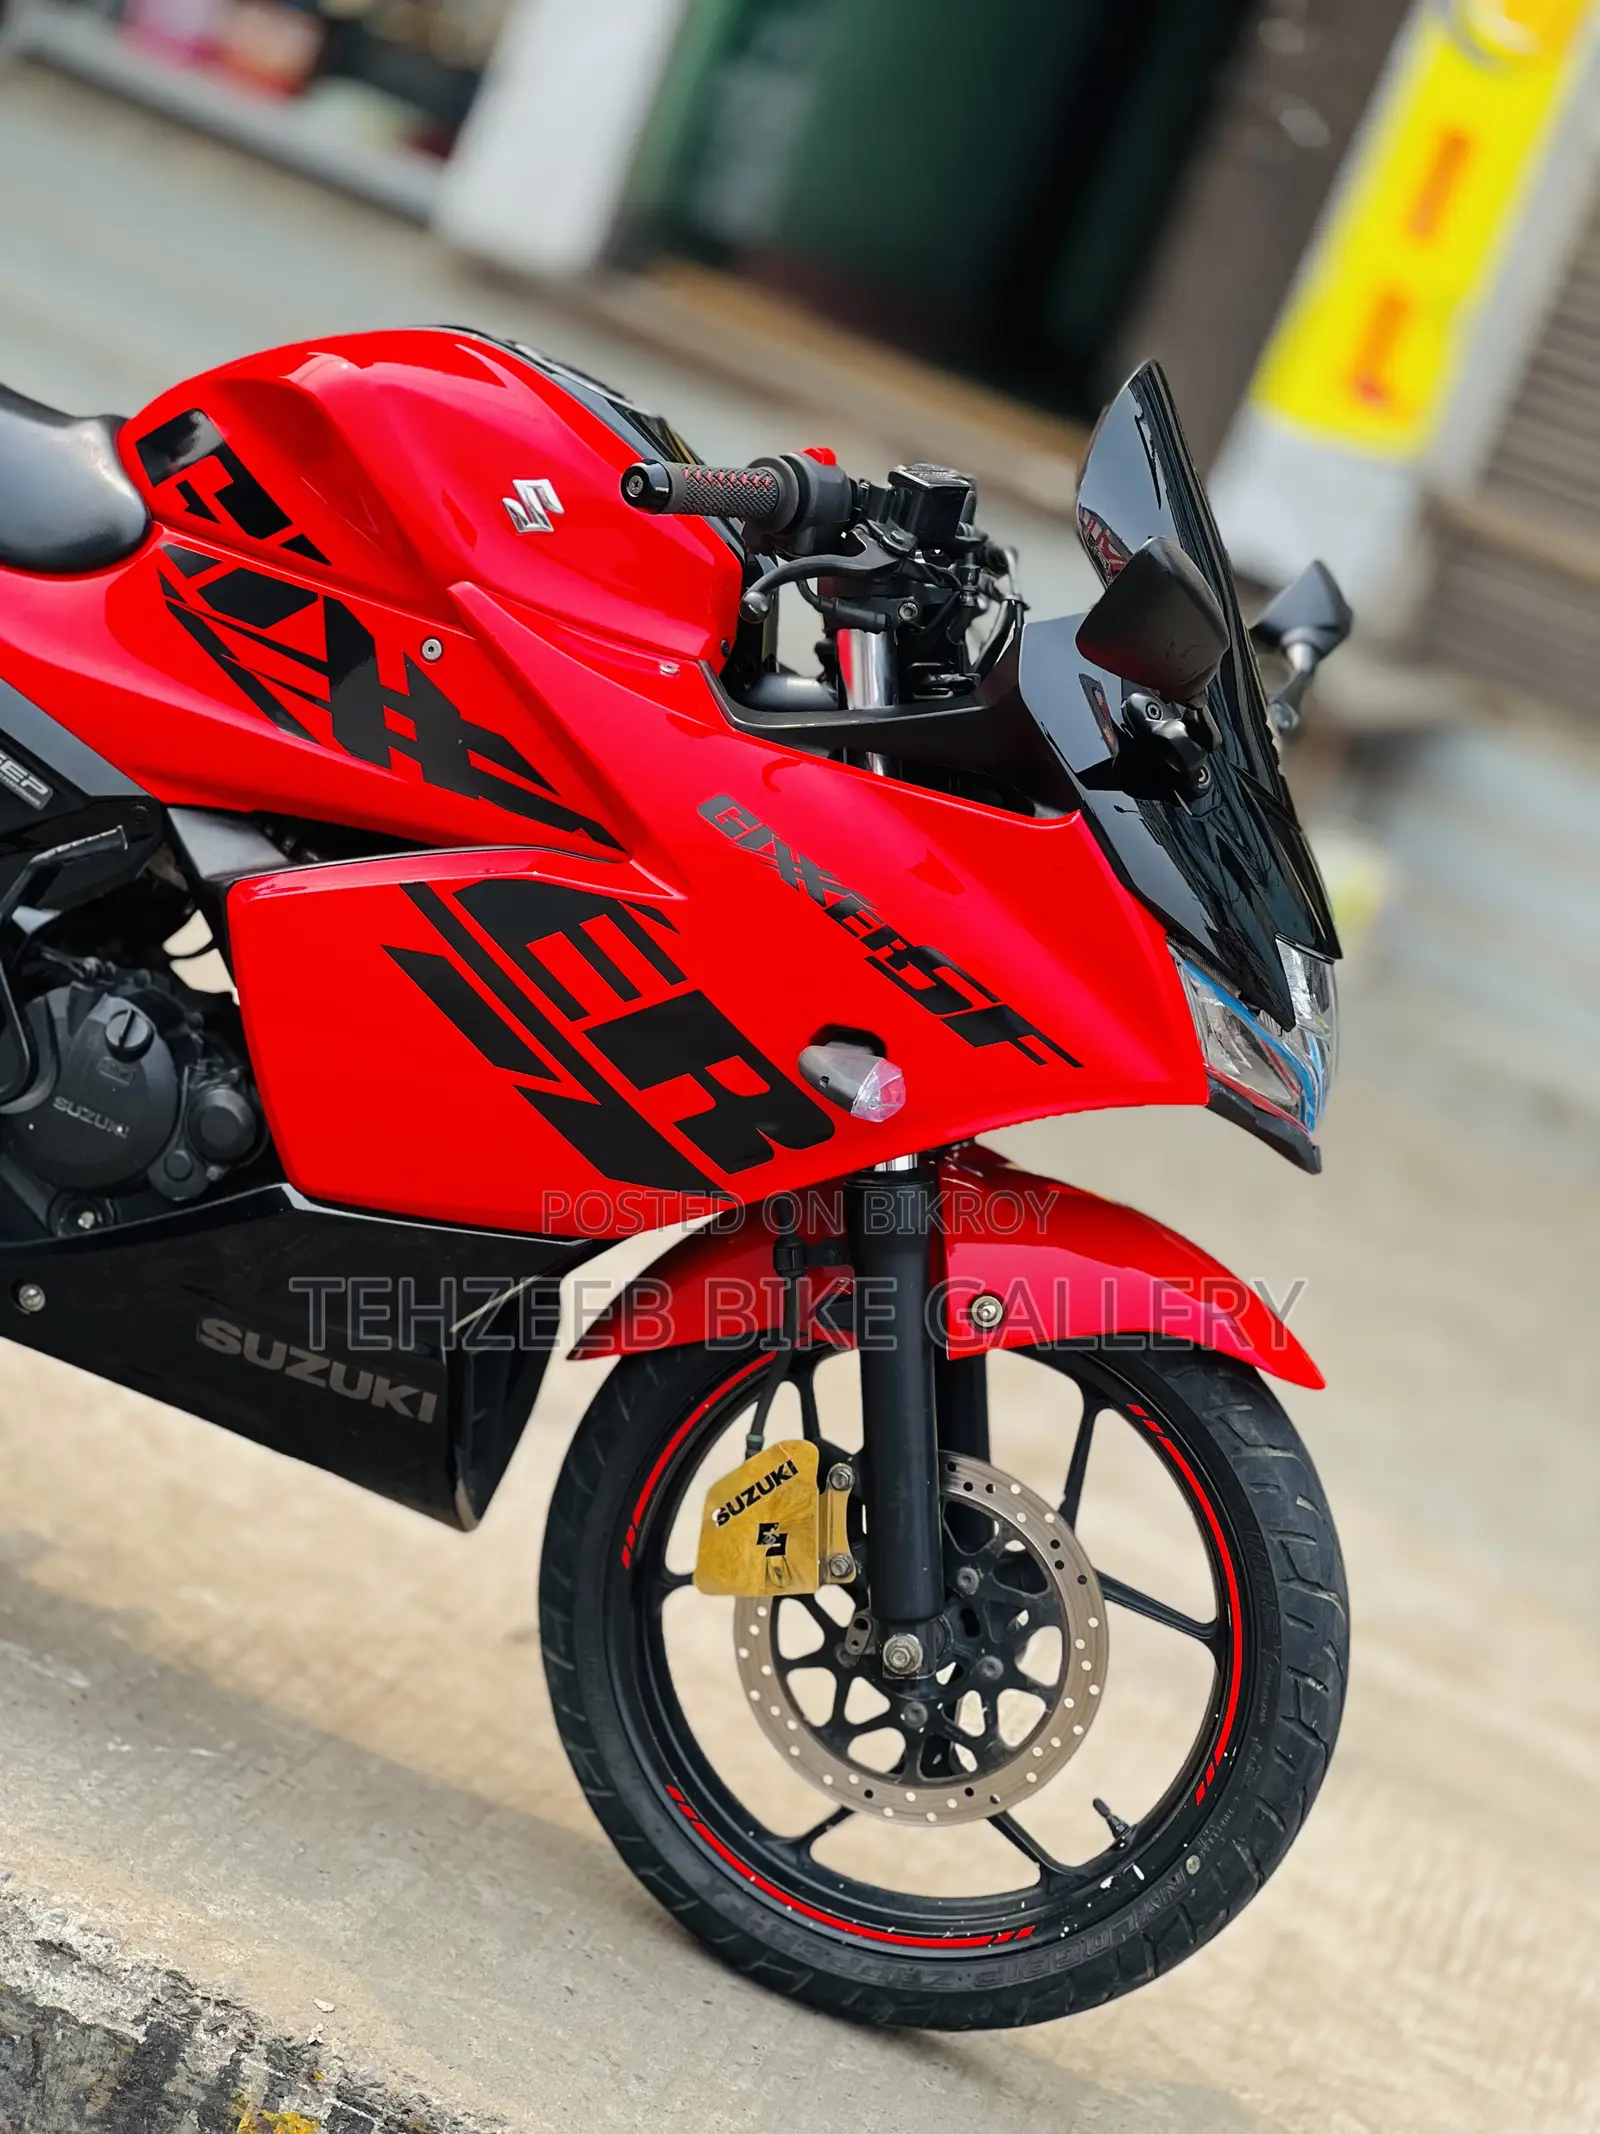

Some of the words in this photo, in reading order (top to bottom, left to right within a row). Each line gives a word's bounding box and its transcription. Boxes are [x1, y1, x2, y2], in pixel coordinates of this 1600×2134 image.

[52, 1095, 131, 1140] SUZUKI
[196, 1317, 438, 1424] SUZUKI
[711, 1458, 799, 1528] SUZUKI
